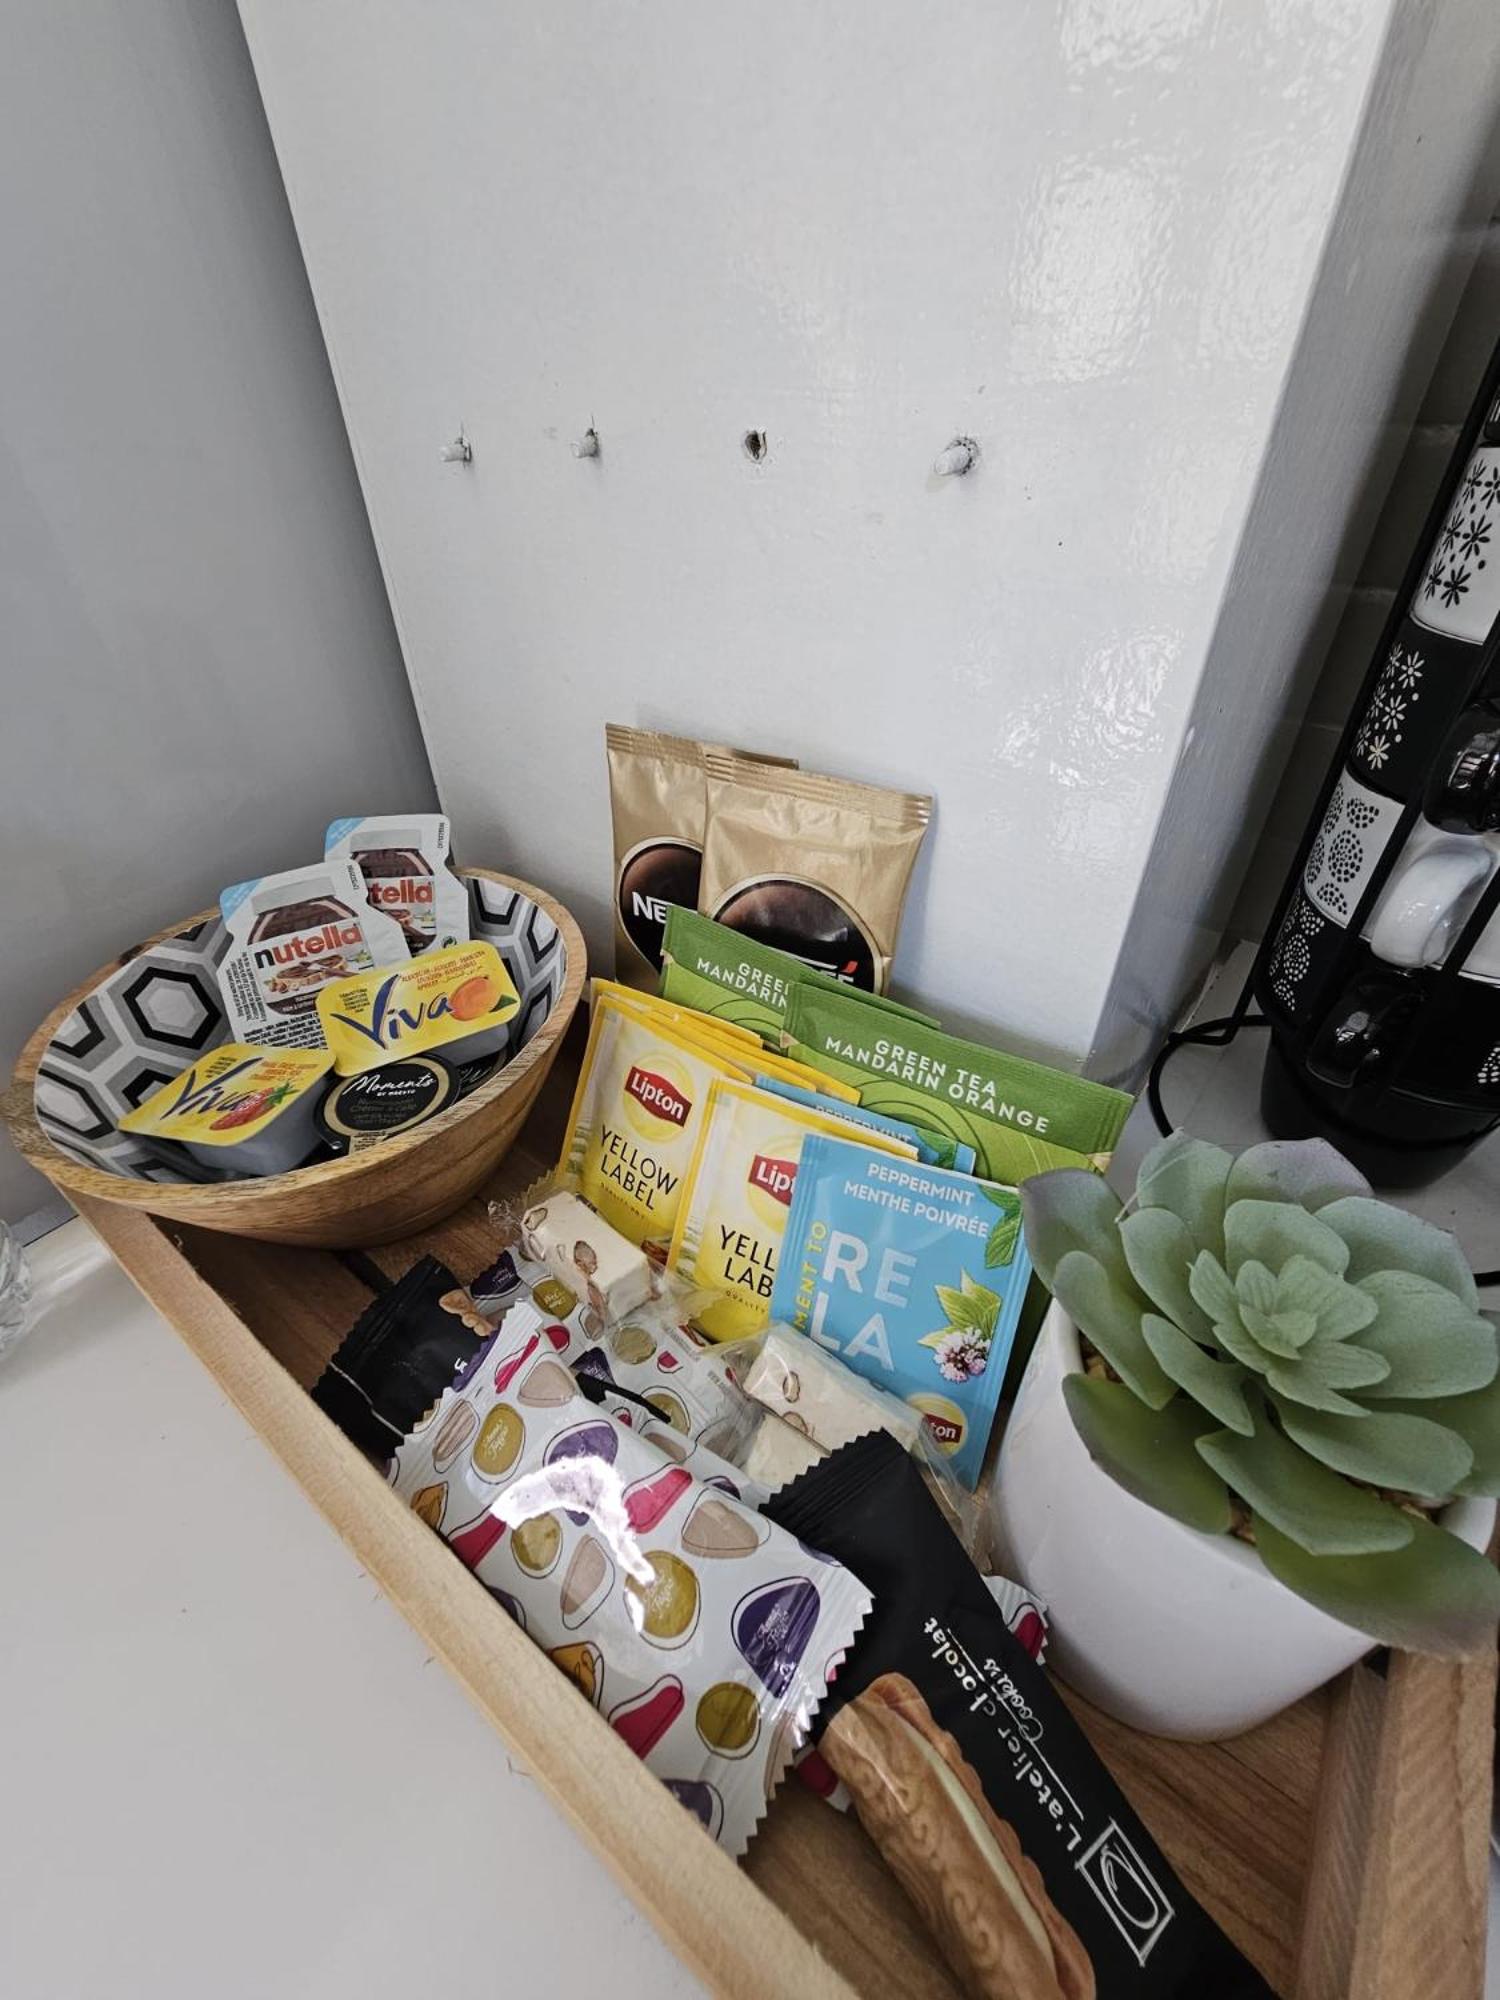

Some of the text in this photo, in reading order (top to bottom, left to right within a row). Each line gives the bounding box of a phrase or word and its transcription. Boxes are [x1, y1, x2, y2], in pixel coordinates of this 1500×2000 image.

[369, 880, 433, 904] tella
[254, 924, 363, 969] nutella
[330, 974, 453, 1049] Viva
[342, 1072, 436, 1095] Moments
[631, 1073, 684, 1119] Lipton
[825, 1036, 940, 1090] MANDARIN
[949, 1083, 1050, 1133] ORANGE
[875, 1040, 997, 1097] GREEN TEA
[600, 1124, 678, 1195] YELLOW
[600, 1153, 654, 1210] LABEL
[756, 1161, 794, 1191] Lip
[867, 1162, 975, 1206] PEPPERMINT
[843, 1181, 990, 1238] MENTHE POIVRÉE
[721, 1224, 775, 1272] YELL
[795, 1221, 828, 1331] MENT TO
[821, 1230, 917, 1309] RE
[724, 1257, 773, 1298] LAB
[809, 1290, 894, 1372] LA
[998, 1727, 1083, 1852] L'atelier
